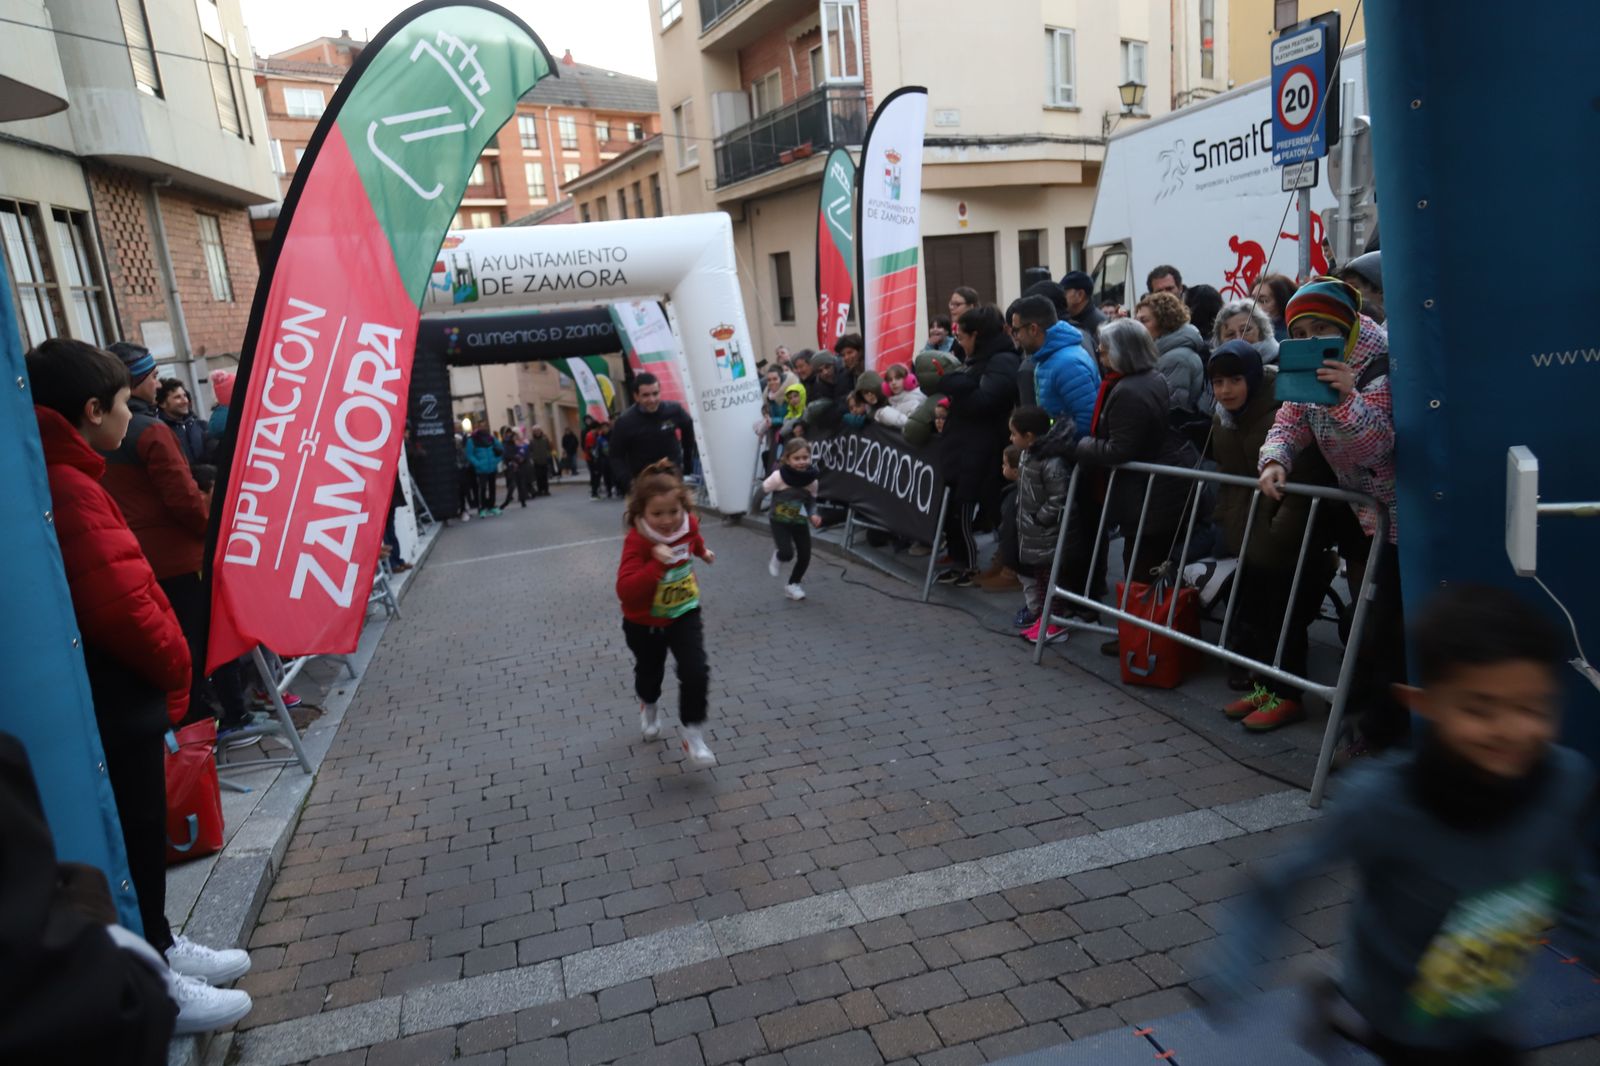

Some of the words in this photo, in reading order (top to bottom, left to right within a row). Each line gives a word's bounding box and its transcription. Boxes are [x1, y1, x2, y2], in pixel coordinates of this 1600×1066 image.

[1284, 84, 1310, 113] 20
[1276, 134, 1320, 149] PREFERENCIA
[1281, 147, 1314, 160] PEATONAL
[867, 207, 879, 219] DE
[880, 210, 916, 225] ZAMORA
[480, 246, 628, 272] AYUNTAMIENTO
[481, 276, 514, 296] DE
[523, 268, 628, 293] ZAMORA
[702, 400, 718, 412] DE
[289, 322, 403, 608] ZAMORA
[854, 437, 934, 515] zamora
